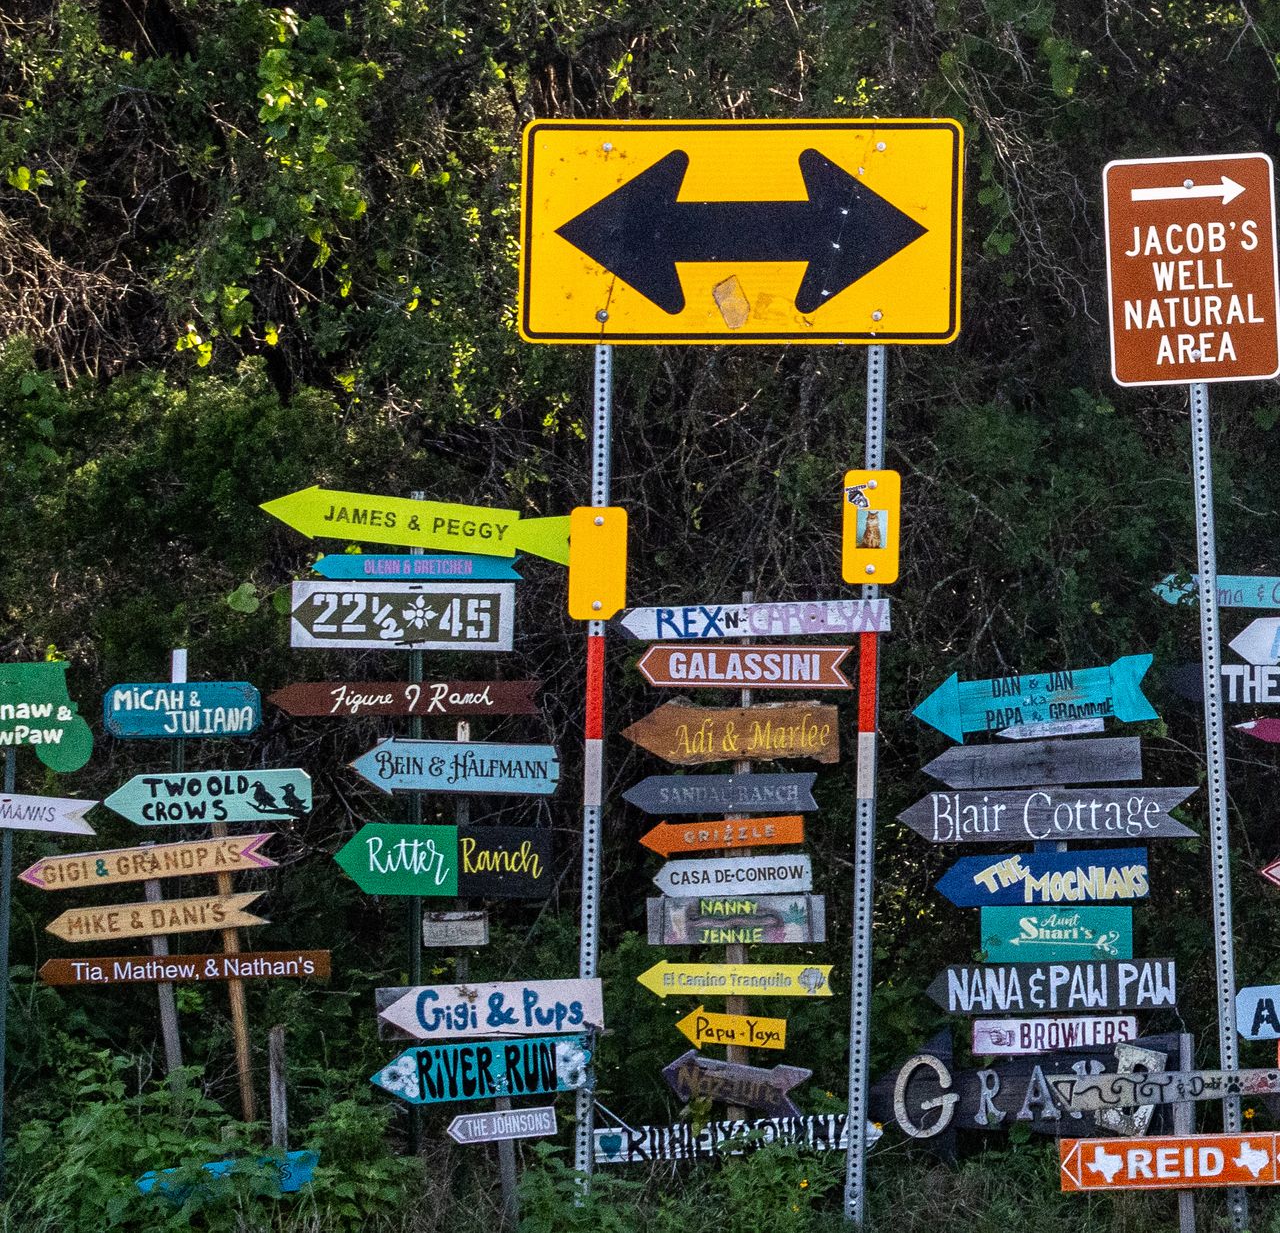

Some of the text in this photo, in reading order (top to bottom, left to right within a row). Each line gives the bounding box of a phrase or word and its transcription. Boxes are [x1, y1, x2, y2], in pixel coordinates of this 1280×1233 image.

[1125, 220, 1259, 257] JACOB'S
[1152, 261, 1233, 290] WELL
[1123, 295, 1265, 326] NATURAL
[1156, 334, 1238, 365] AREA
[324, 505, 509, 541] JAMES PEGGY
[364, 559, 473, 575] GLENN GRETCHEN
[439, 598, 492, 639] 45
[656, 606, 726, 639] REX
[668, 652, 820, 681] GALASSINI
[331, 684, 494, 715] Figure Ranch
[991, 671, 1074, 698] DAN JAN
[1221, 666, 1280, 704] THE
[164, 708, 252, 734] JULIANA
[986, 707, 1025, 729] PAPA
[670, 713, 831, 756] Adi Marlee
[142, 775, 249, 797] TWO OLD
[142, 801, 229, 821] CROWS
[931, 791, 1161, 841] Blair Cottage
[42, 862, 89, 884] GIGI
[366, 836, 543, 886] Ritter Ranch
[670, 866, 804, 886] CASA CONROW
[973, 854, 1031, 893] THE
[67, 903, 226, 936] MIKE DANI'S
[701, 901, 758, 915] NANNY
[1041, 913, 1079, 928] Aunt
[224, 957, 315, 976] Nathan's
[663, 973, 792, 988] El Camino Tranquilo
[947, 960, 1176, 1011] NANA PAW PAW
[416, 988, 584, 1032] Gigi Pups
[503, 1042, 559, 1094] RUN
[465, 1112, 551, 1136] THE JOHNSONS
[1127, 1147, 1224, 1179] REID
